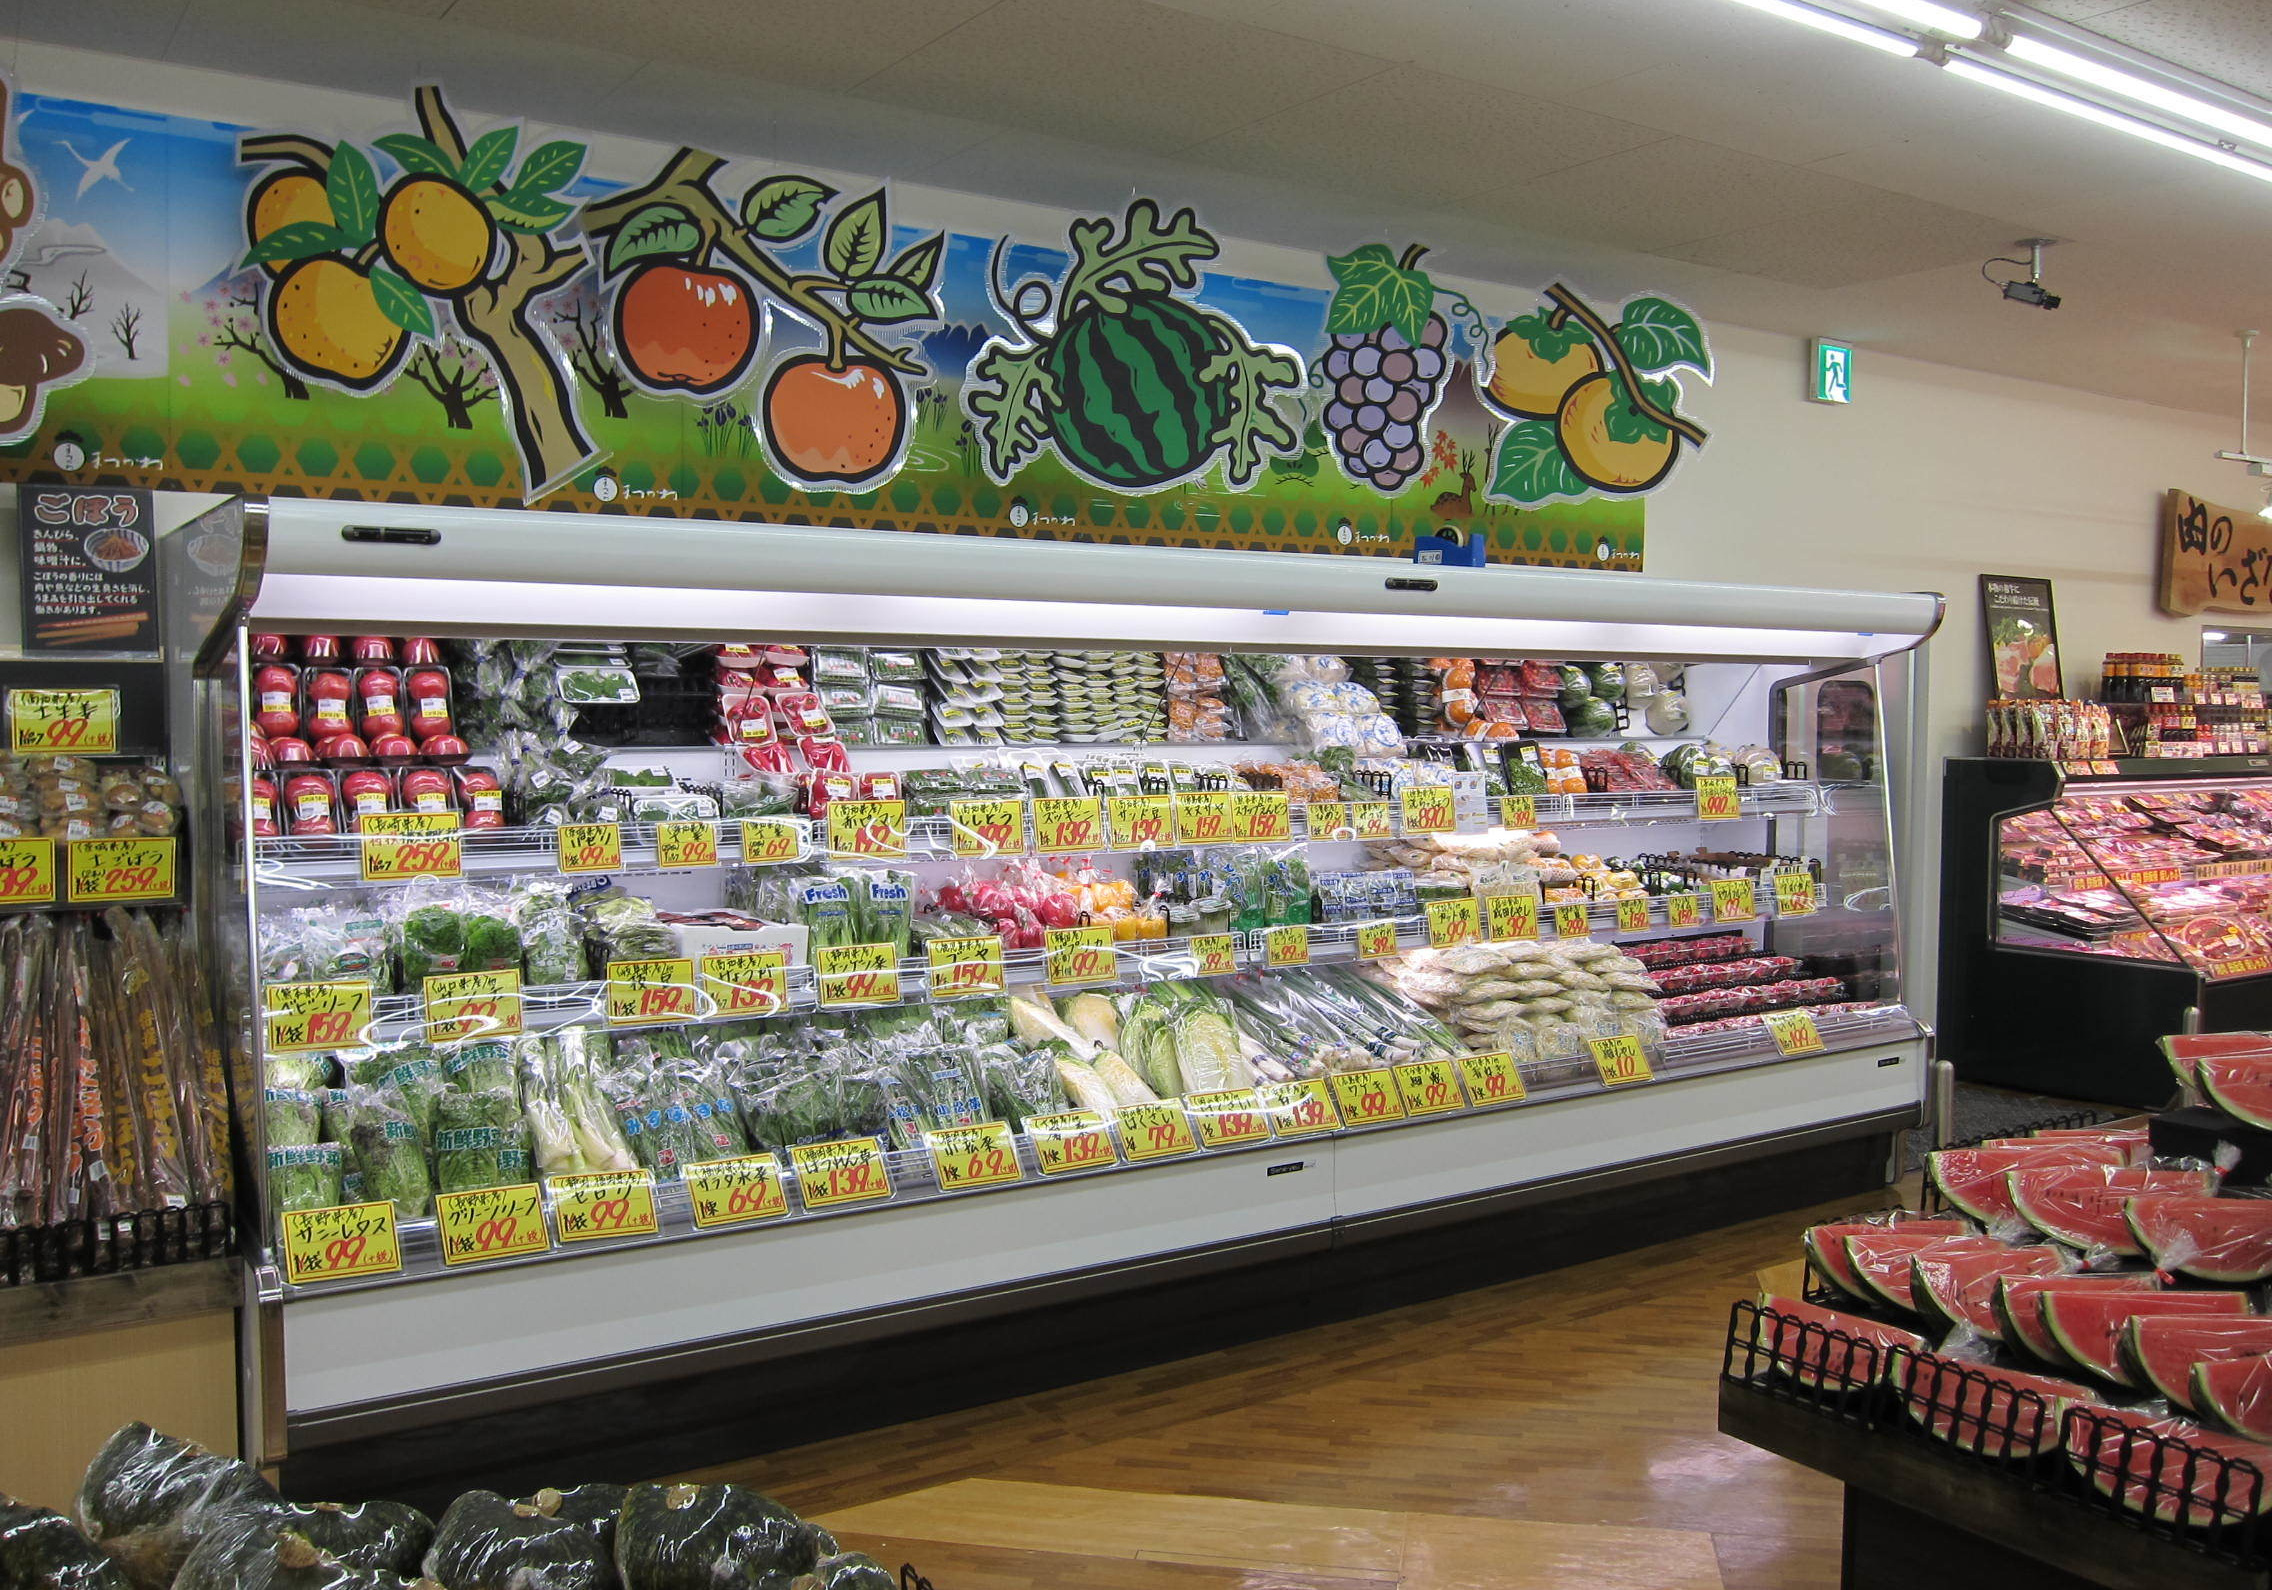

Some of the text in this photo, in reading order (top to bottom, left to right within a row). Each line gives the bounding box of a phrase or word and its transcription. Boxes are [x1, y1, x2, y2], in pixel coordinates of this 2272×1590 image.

[34, 493, 138, 527] ごぼう
[33, 571, 104, 582] ごぼうの香りには
[46, 717, 89, 747] 99
[960, 812, 1013, 827] ししとう
[1196, 815, 1222, 838] 159
[1249, 815, 1277, 838] 159
[1324, 819, 1341, 836] 69
[1367, 819, 1382, 834] 99
[1418, 806, 1447, 830] 890
[1056, 820, 1092, 847] 139
[1131, 818, 1163, 843] 139
[396, 843, 451, 872] 259
[580, 846, 604, 865] 99
[683, 842, 706, 862] 99
[765, 838, 791, 856] 69
[104, 867, 159, 894] 259
[871, 883, 907, 900] Fresh
[806, 885, 848, 902] Fresh
[1446, 919, 1468, 943] 99
[1506, 916, 1528, 938] 39
[1281, 945, 1297, 959] 99
[1373, 937, 1389, 954] 39
[1071, 951, 1099, 978] 99
[1205, 953, 1223, 970] 99
[846, 973, 878, 998] 99
[952, 962, 989, 990] 159
[640, 987, 684, 1016] 159
[305, 1011, 354, 1044] 159
[1789, 1028, 1809, 1048] 199
[1616, 1056, 1637, 1078] 10
[1425, 1082, 1448, 1107] 99
[1484, 1075, 1506, 1098] 99
[1291, 1100, 1325, 1128] 139
[1361, 1091, 1387, 1115] 99
[1124, 1111, 1175, 1130] はくさい
[1217, 1112, 1253, 1138] 139
[944, 1136, 998, 1158] 小松菜
[1063, 1132, 1100, 1163] 139
[1148, 1123, 1176, 1150] 79
[968, 1150, 1004, 1179] 69
[697, 1166, 771, 1192] サラダ水菜
[828, 1164, 872, 1197] 139
[571, 1184, 633, 1205] セロリ
[728, 1181, 768, 1215] 69
[292, 1206, 366, 1228] (長野県産)
[448, 1196, 538, 1227] グリーンリーフ
[590, 1198, 631, 1231] 99
[295, 1216, 388, 1244] サニーレタス
[475, 1216, 518, 1251] 99
[325, 1236, 368, 1270] 99
